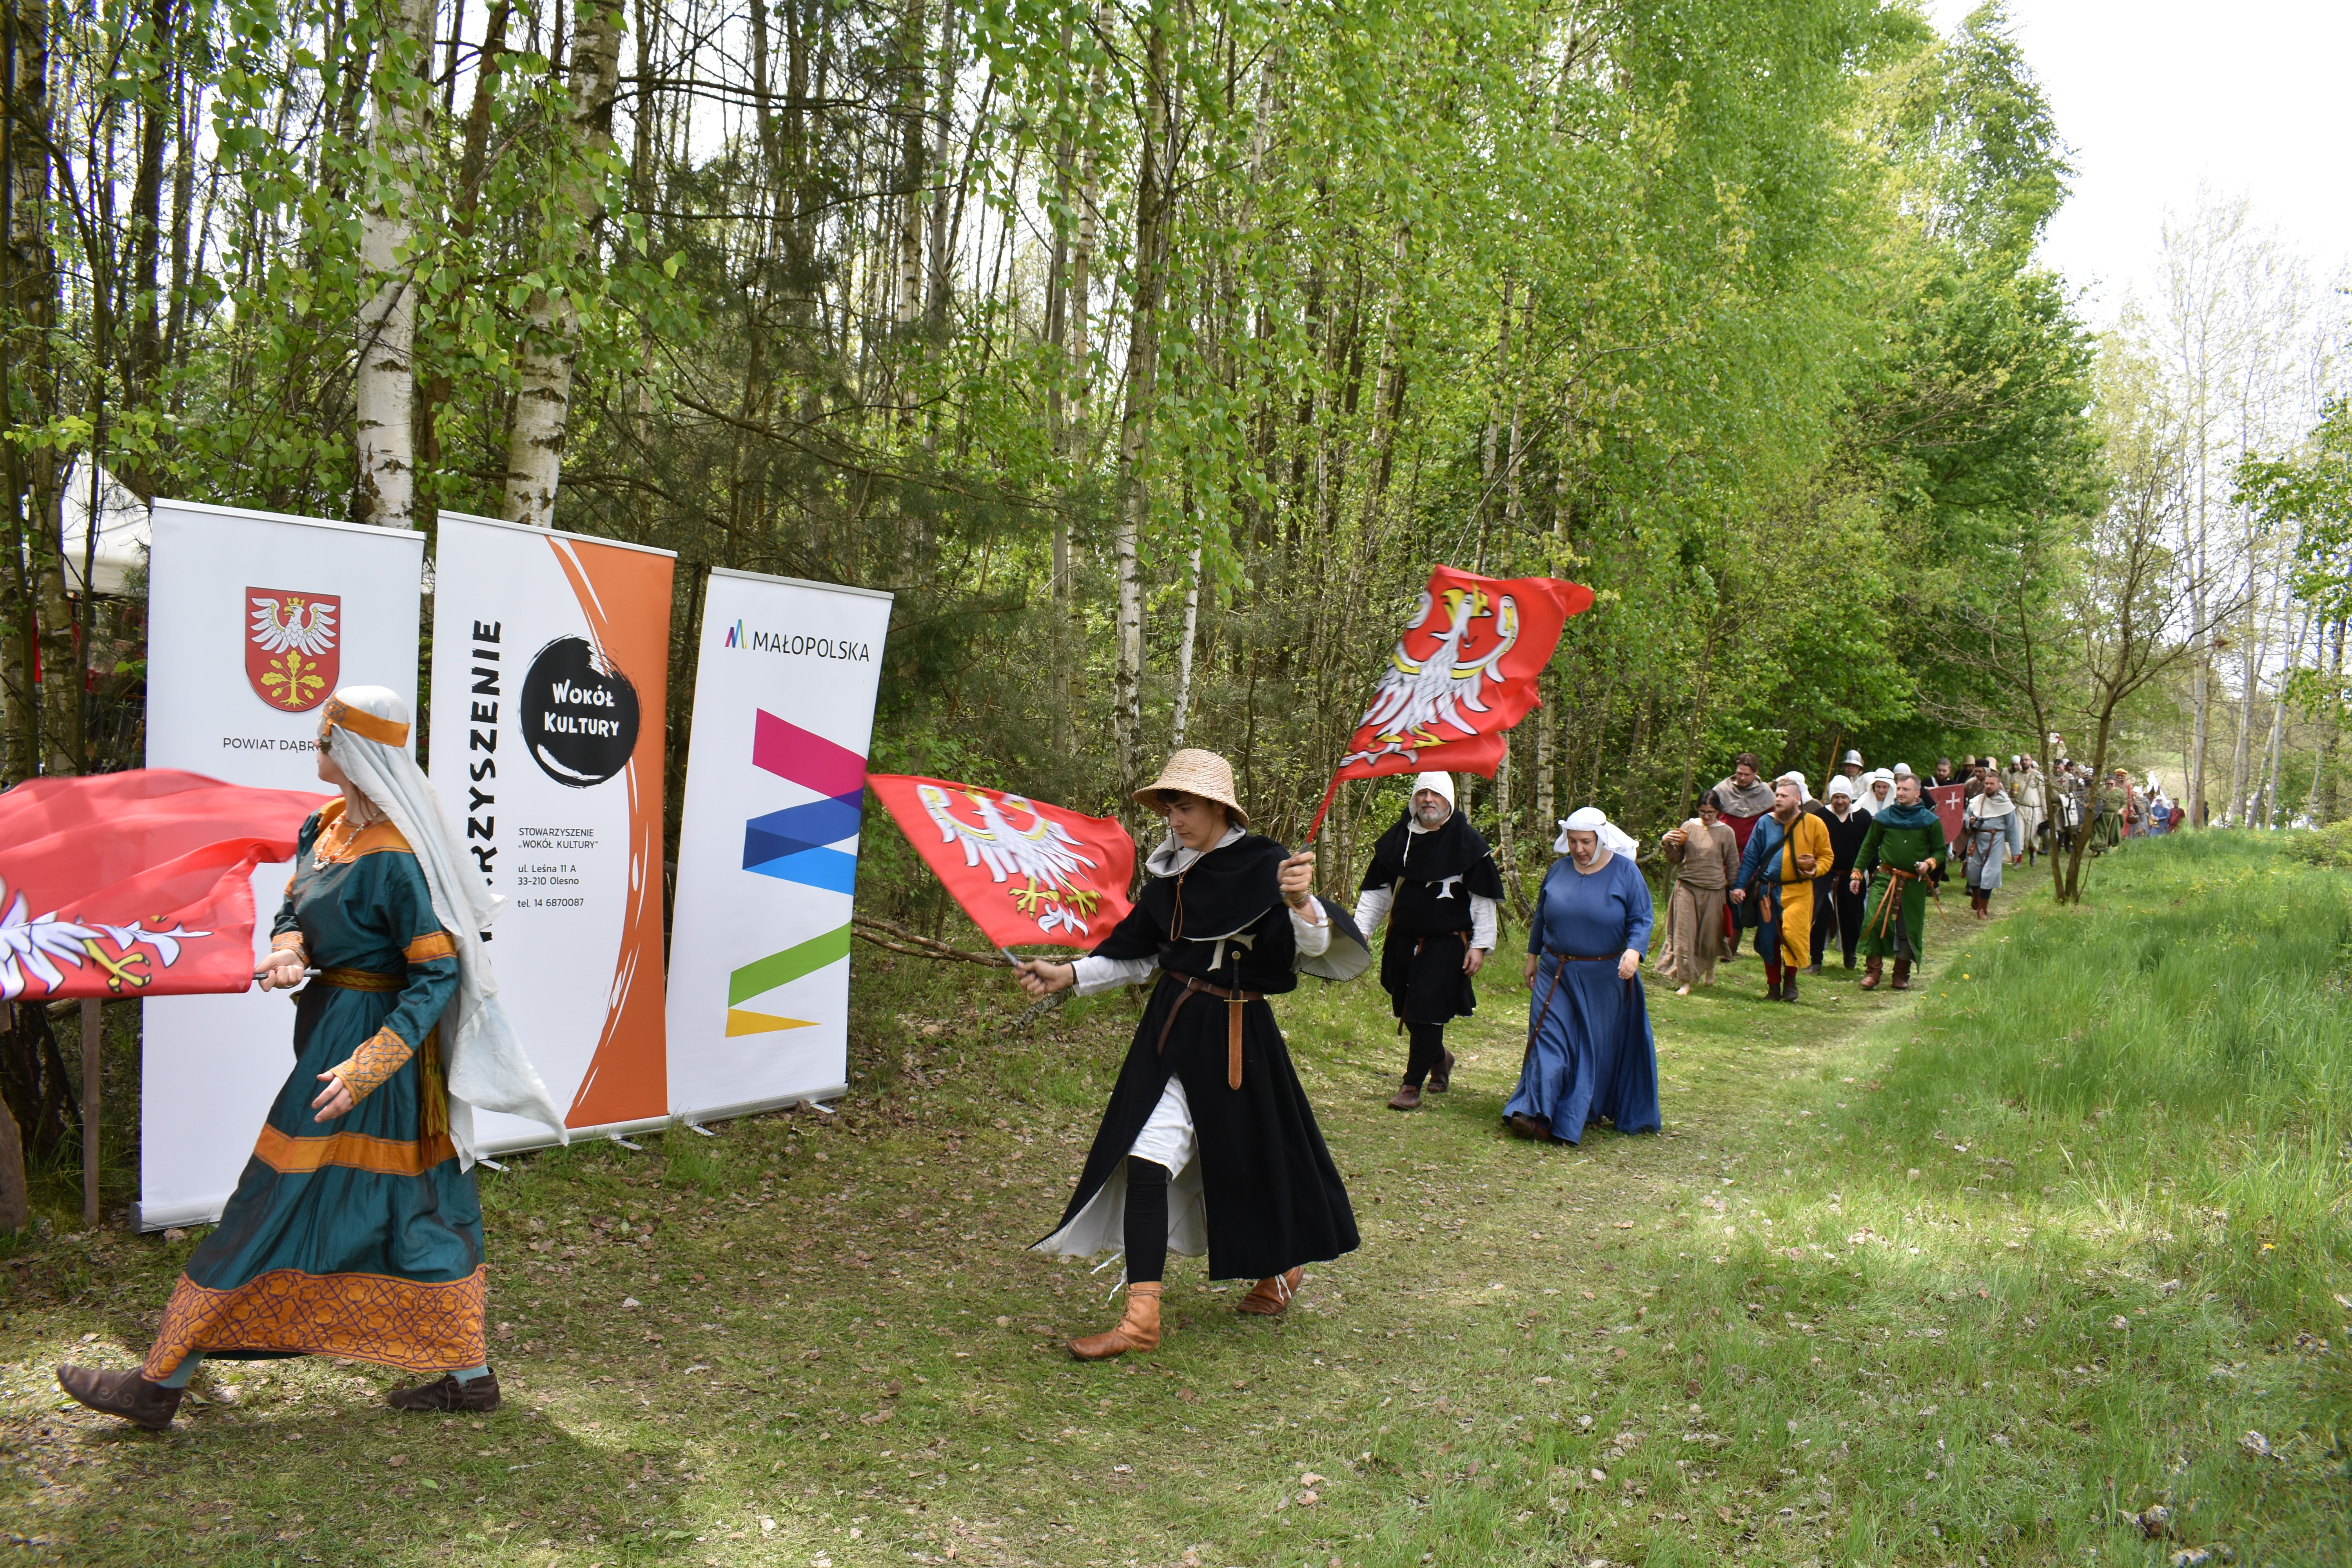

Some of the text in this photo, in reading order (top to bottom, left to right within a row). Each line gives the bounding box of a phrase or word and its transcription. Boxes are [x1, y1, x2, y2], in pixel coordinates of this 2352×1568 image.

[753, 631, 869, 662] MAŁOPOLSKA
[223, 737, 319, 753] POWIAT DĄBR
[468, 620, 502, 942] RZYSZENIE
[519, 828, 594, 837] STOWARZYSZENIE
[518, 864, 576, 873] ul. Leśna 11 A
[517, 877, 579, 885] 33-210 Olesno
[517, 898, 584, 907] tel. 14 6870087
